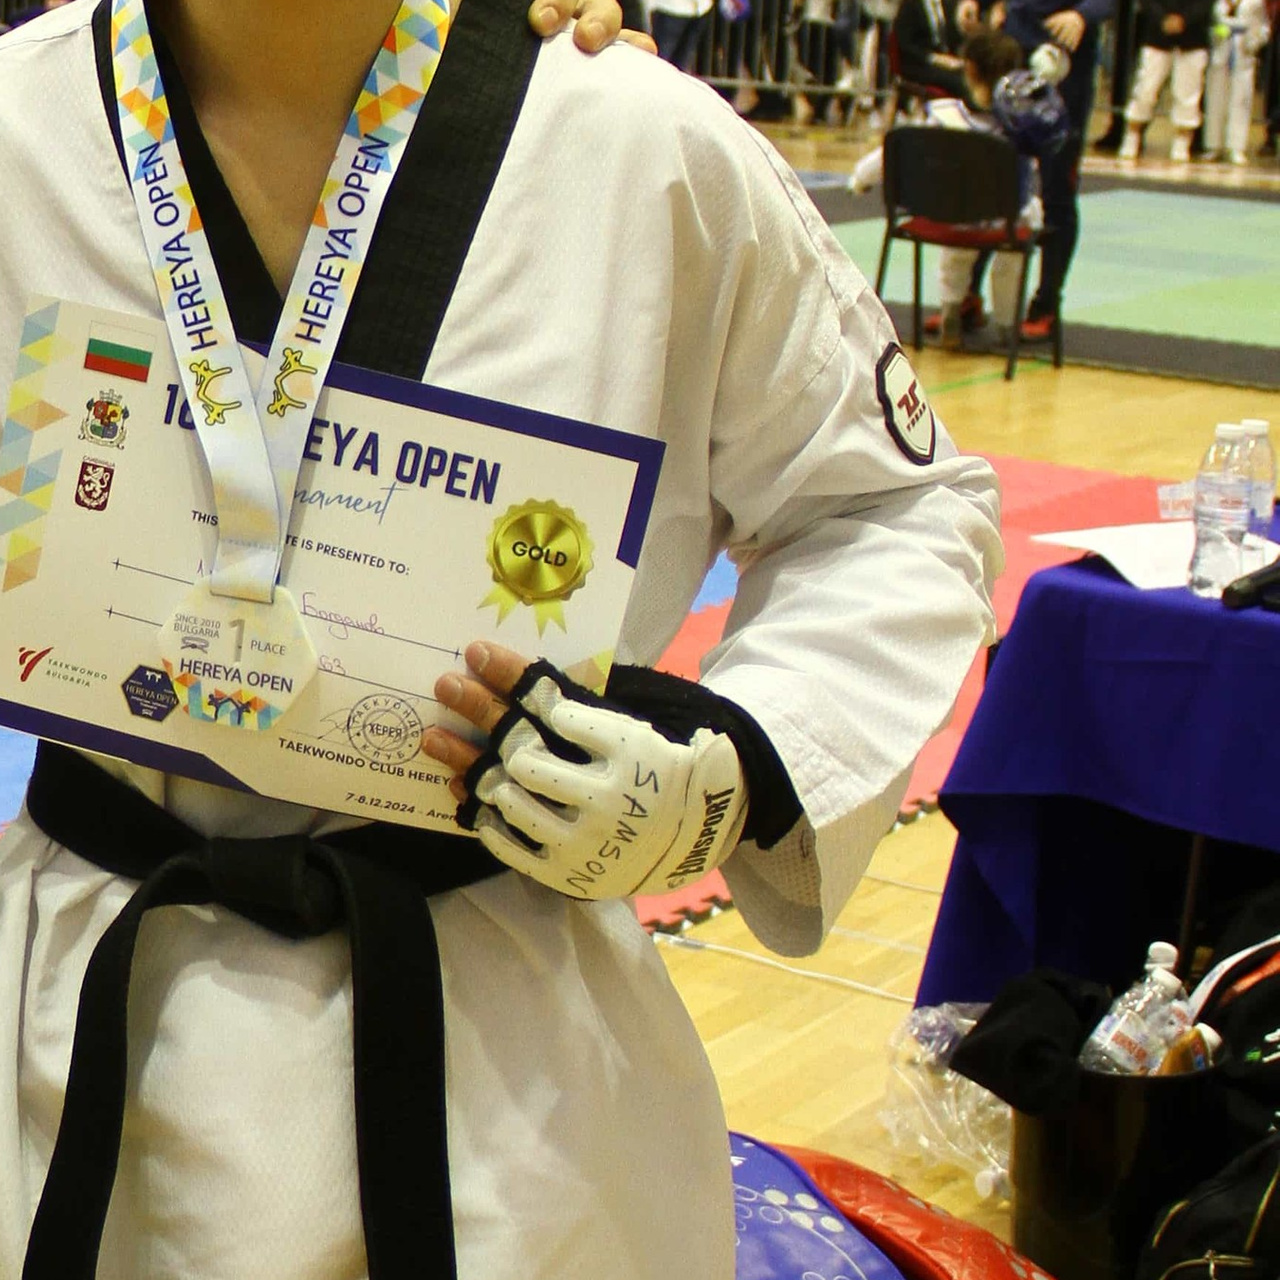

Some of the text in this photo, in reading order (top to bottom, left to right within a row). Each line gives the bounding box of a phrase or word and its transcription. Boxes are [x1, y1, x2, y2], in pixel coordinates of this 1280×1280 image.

[138, 141, 218, 351] HEREYA OPEN
[294, 133, 390, 344] HEREYA OPEN
[302, 416, 380, 477] EYA
[394, 440, 502, 505] OPEN
[191, 509, 219, 527] THIS
[293, 481, 410, 525] nament
[301, 538, 314, 551] IS
[316, 542, 385, 569] PRESENTED
[389, 560, 410, 576] TO:
[511, 540, 568, 568] GOLD
[173, 623, 221, 639] BULGARIA
[174, 613, 221, 629] SINCE 2010
[227, 618, 246, 663] 1
[250, 639, 287, 656] PLACE
[48, 658, 108, 681] TAEKWONDO
[179, 658, 294, 694] HEREYA OPEN
[278, 737, 452, 787] TAEKWONDO CLUB HEREY
[344, 791, 457, 822] 7-8.12.2024 Aren
[565, 760, 659, 896] SAMSON
